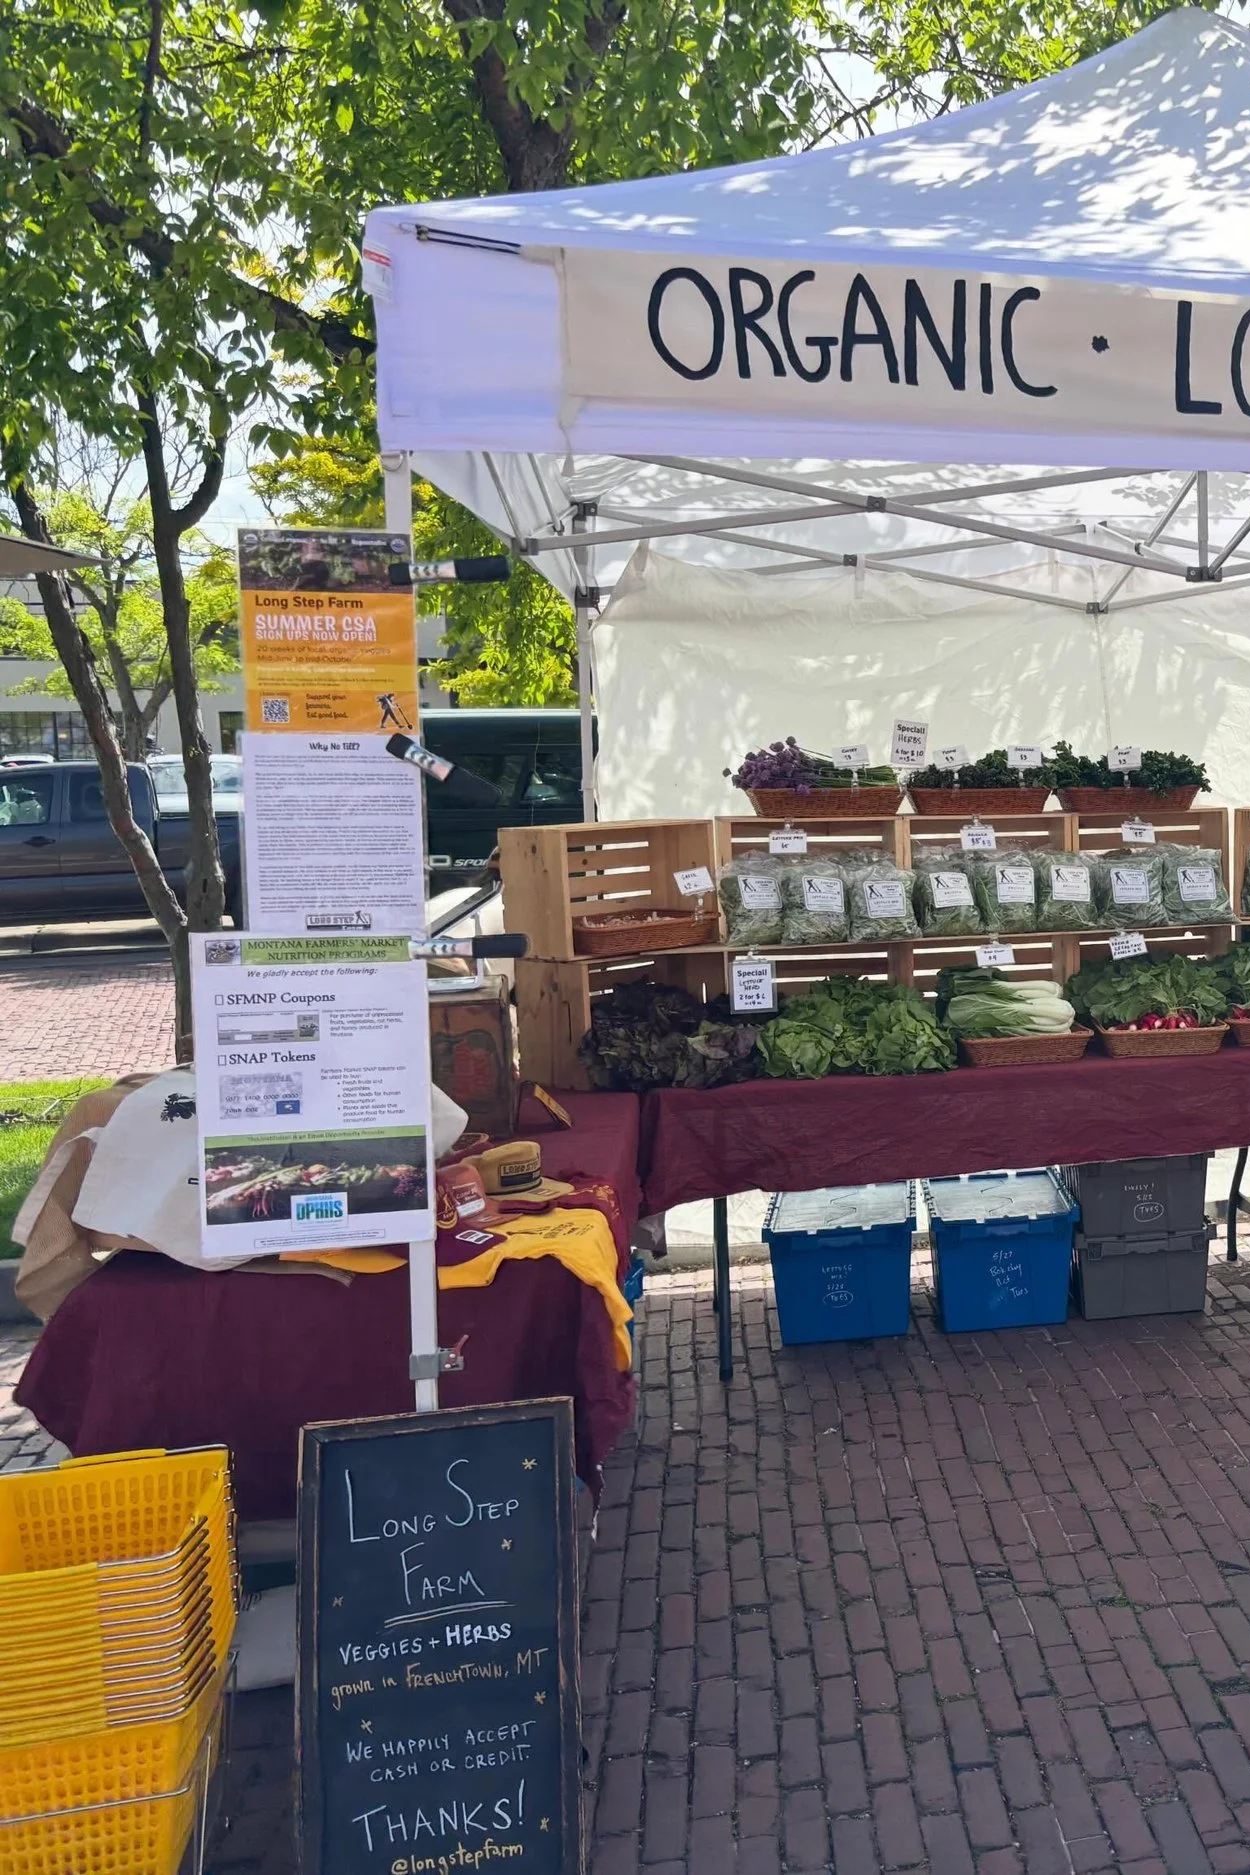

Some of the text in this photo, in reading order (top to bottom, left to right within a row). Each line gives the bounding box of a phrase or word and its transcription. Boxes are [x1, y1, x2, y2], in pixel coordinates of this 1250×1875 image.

[647, 266, 1058, 398] ORGANIC
[255, 594, 364, 610] Long Step Farm
[255, 614, 376, 632] SUMMER CSA
[255, 630, 377, 642] SIGN UPS NOW OPEN!
[318, 711, 333, 719] good
[309, 742, 361, 751] Why No Till?
[900, 748, 909, 756] for
[248, 938, 405, 950] MONTANA FARMERS' MARKET
[268, 950, 387, 961] NUTRITION PROGRAMS
[247, 967, 379, 978] We gladly accept the following:
[227, 991, 337, 1006] SFMNP Coupons
[229, 1051, 316, 1065] SNAP Tokens
[345, 1459, 520, 1543] LONG STEP
[400, 1541, 486, 1606] FARM
[339, 1637, 423, 1666] VEGGIES
[445, 1622, 513, 1647] HERBS
[331, 1678, 375, 1711] grown
[382, 1677, 398, 1688] in
[517, 1647, 550, 1675] MT
[346, 1720, 537, 1763] WE HAPPILY ACCEPT
[370, 1743, 532, 1783] CASH OR CREDIT.
[352, 1778, 526, 1853] THANKS!
[391, 1837, 524, 1875] @longstepfarm
